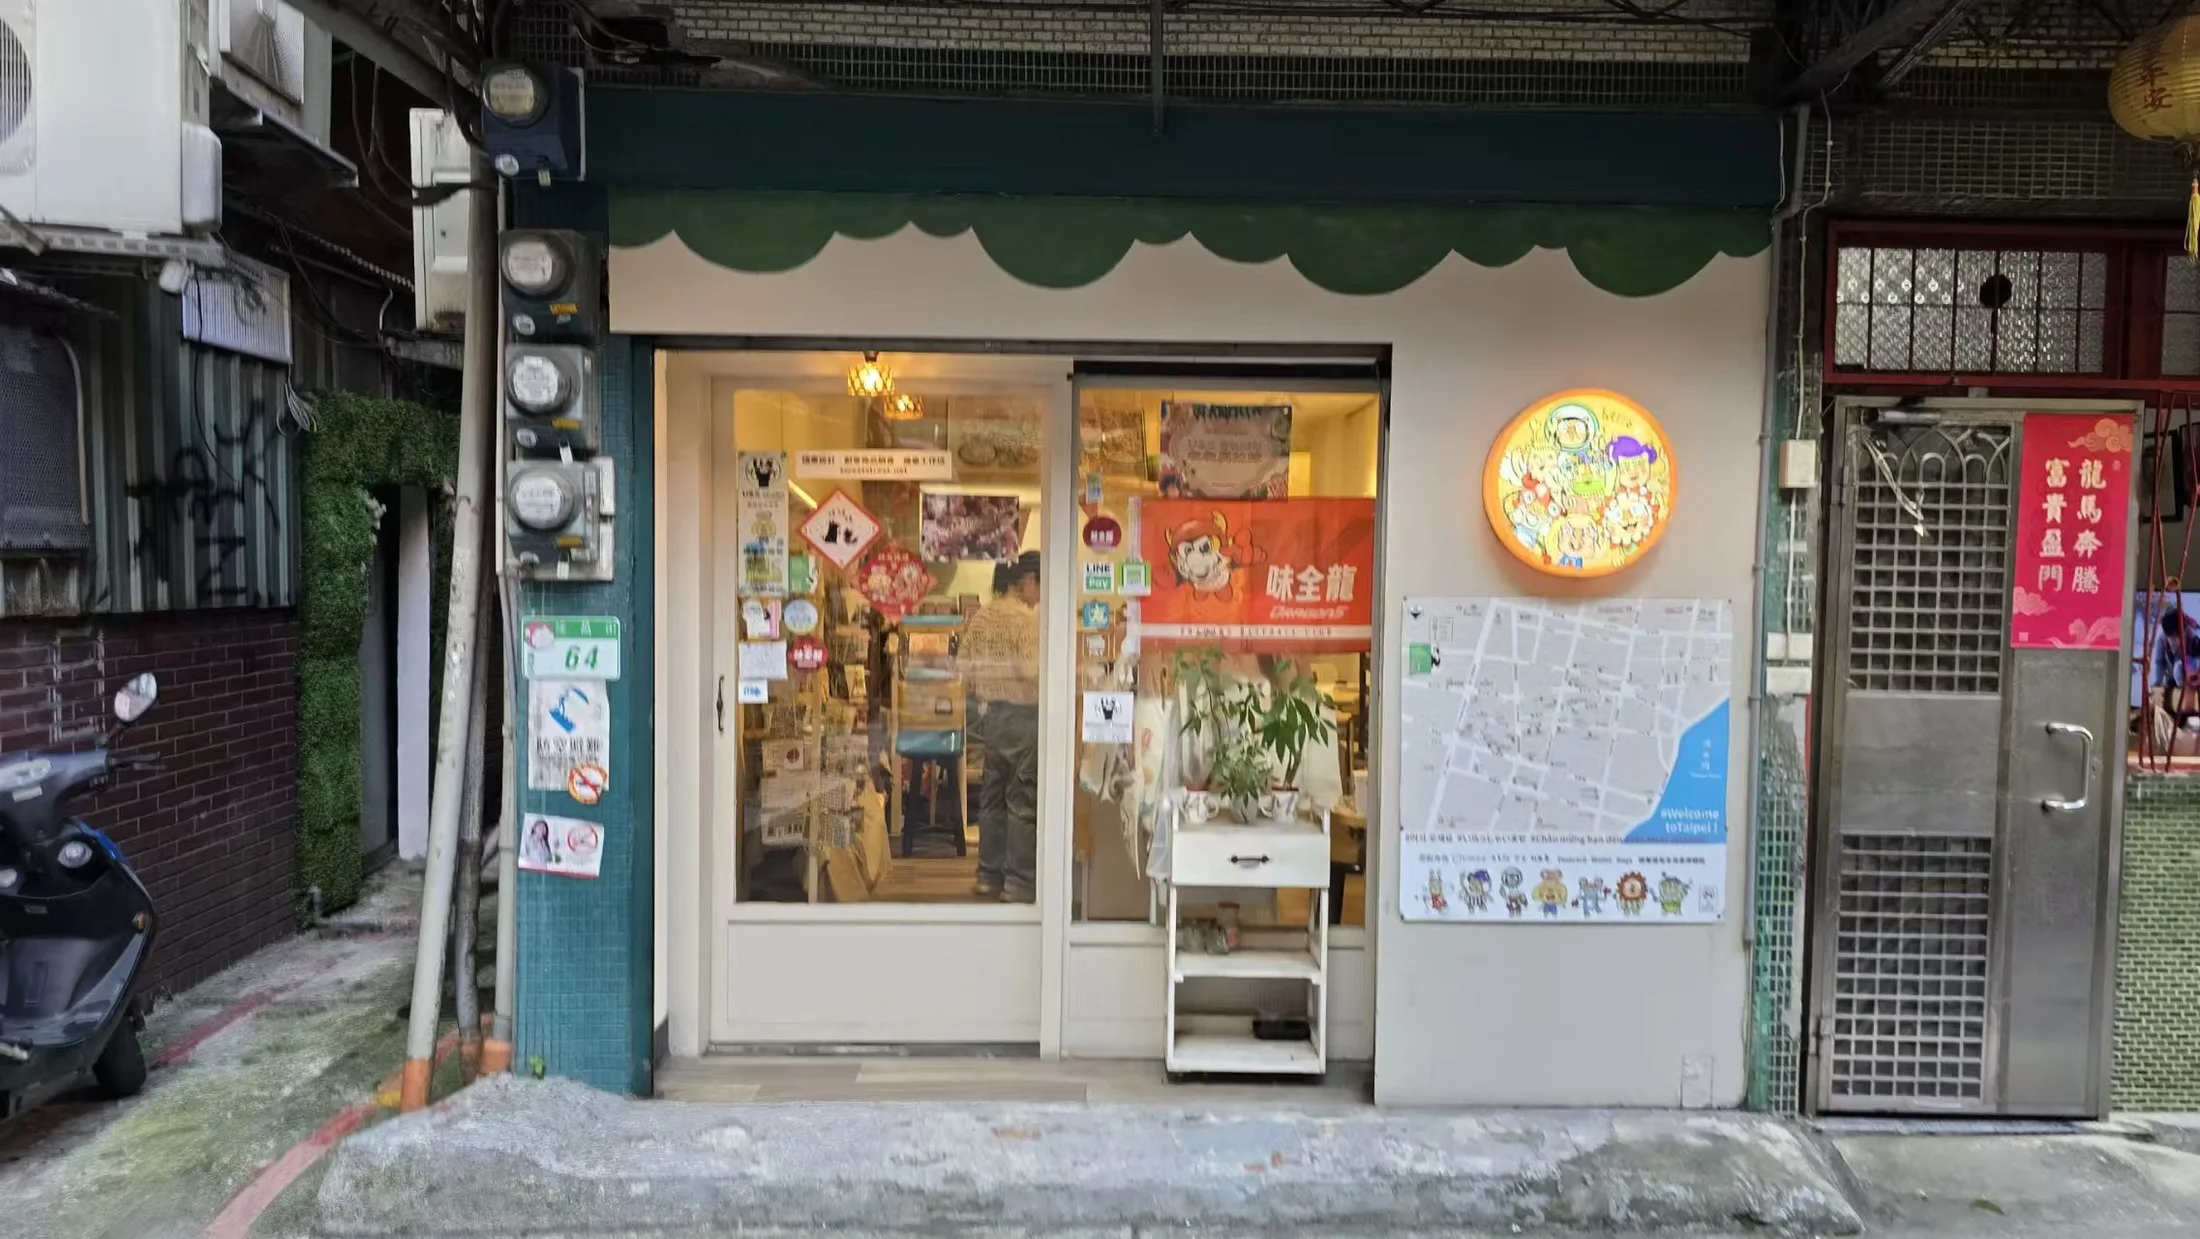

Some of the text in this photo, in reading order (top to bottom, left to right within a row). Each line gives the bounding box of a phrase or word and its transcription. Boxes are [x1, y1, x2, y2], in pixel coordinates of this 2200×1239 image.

[2037, 457, 2070, 593] 富貴盈門
[2071, 457, 2107, 595] 龍馬奔騰
[1086, 563, 1111, 573] LINE
[1088, 577, 1109, 590] Pay
[1265, 563, 1358, 603] 味全龍
[564, 643, 600, 671] 64
